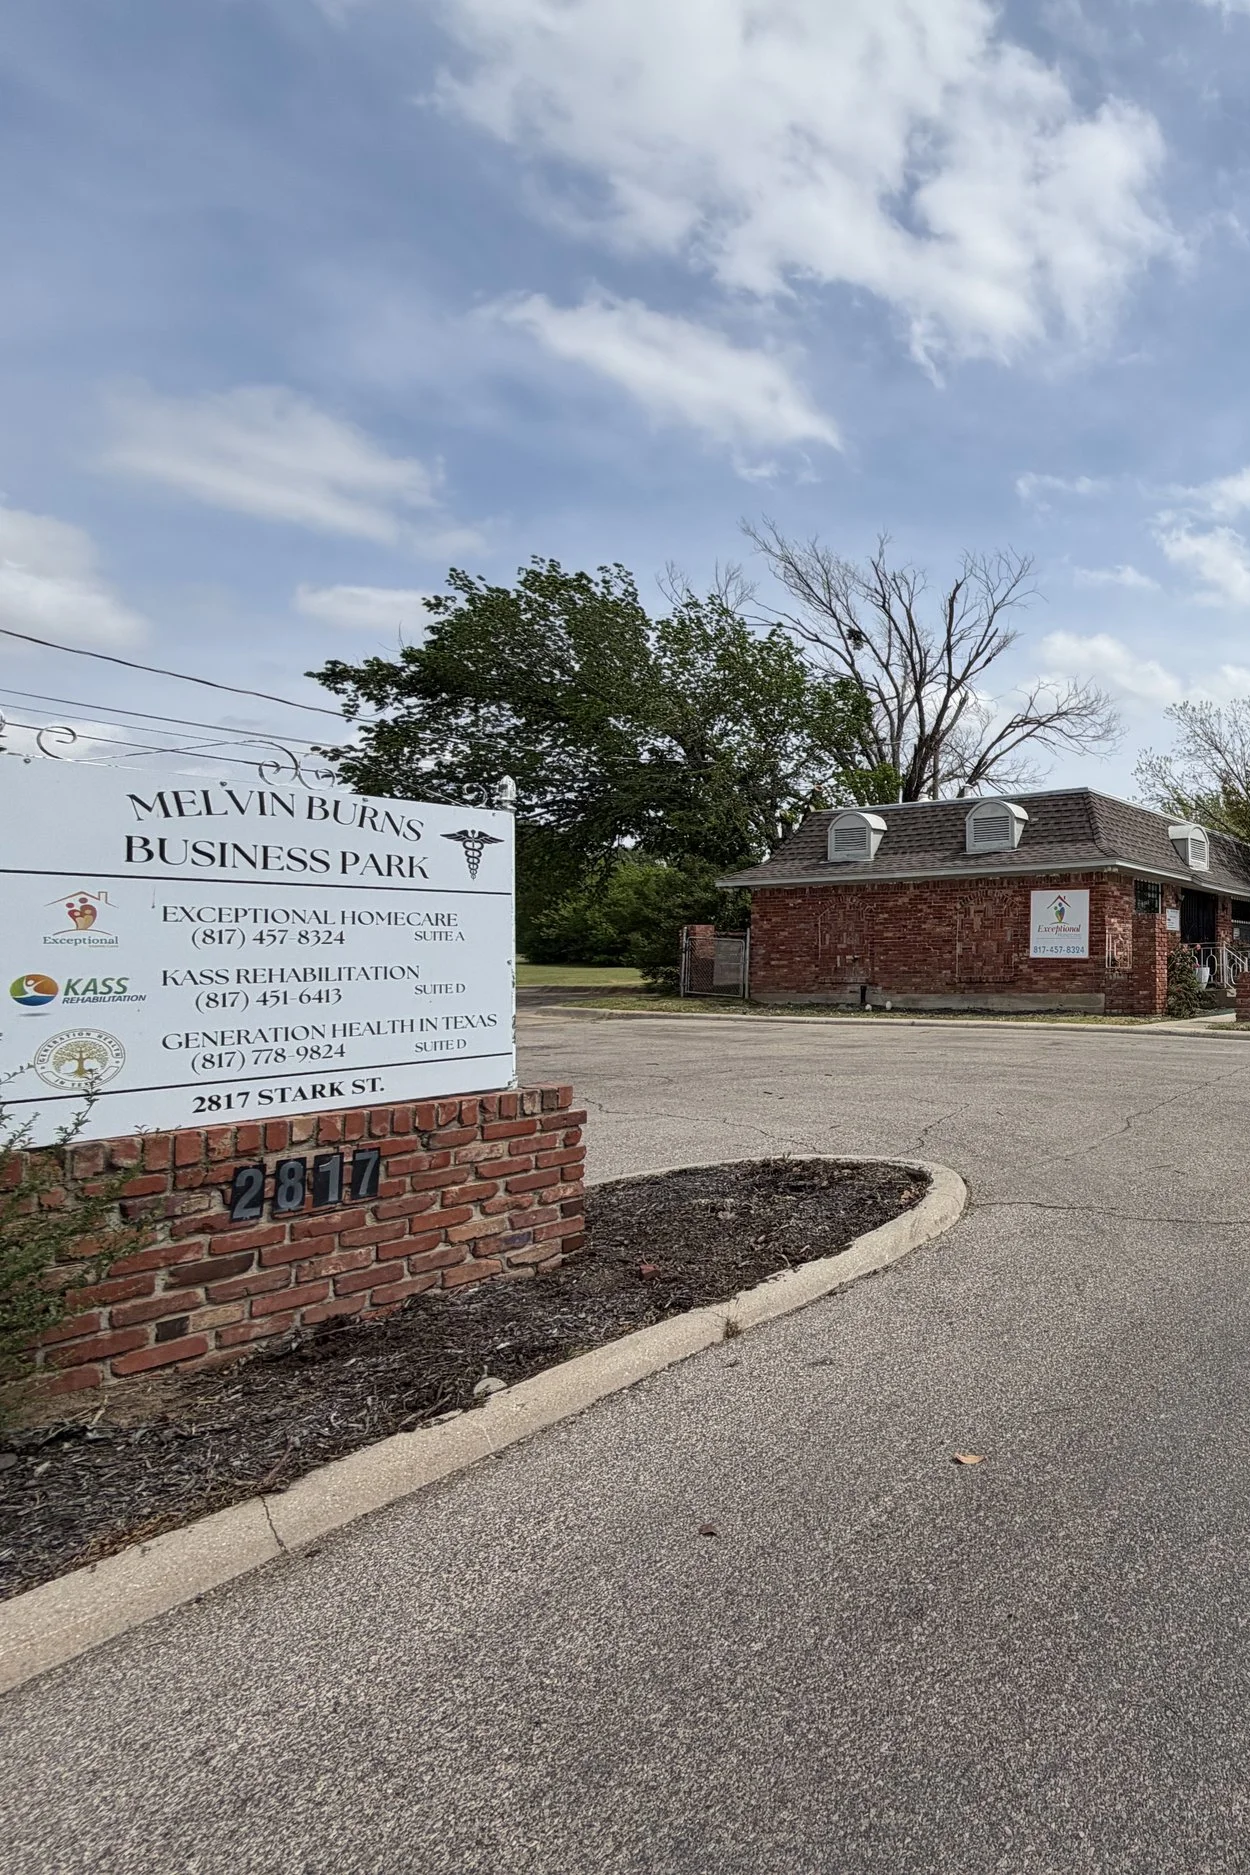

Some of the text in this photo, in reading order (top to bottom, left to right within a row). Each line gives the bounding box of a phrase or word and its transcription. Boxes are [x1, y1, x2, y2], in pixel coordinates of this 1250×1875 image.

[126, 789, 424, 842] MELVIN BURNS
[124, 835, 429, 879] BUSINESS PARK
[162, 905, 458, 927] EXCEPTIONAL HOMECARE
[191, 927, 346, 950] (817) 457-8324
[414, 930, 465, 942] SUITE A
[1037, 924, 1081, 935] Exceptional
[43, 936, 119, 947] Exceptional
[1033, 945, 1085, 954] 817-457-8324
[162, 965, 420, 986] KASS REHABILITATION
[63, 977, 130, 997] KASS
[414, 983, 466, 995] SUITE D
[62, 995, 147, 1005] REHABILITATION
[195, 987, 342, 1014] (817) 451-6413
[162, 1013, 498, 1051] GENERATION HEALTH IN TEXAS
[39, 1032, 91, 1063] GENERATION
[414, 1039, 467, 1053] SUITE D
[191, 1043, 346, 1076] (817) 778-9824
[192, 1077, 385, 1114] 2817 STARK ST.
[232, 1150, 380, 1220] 2817
